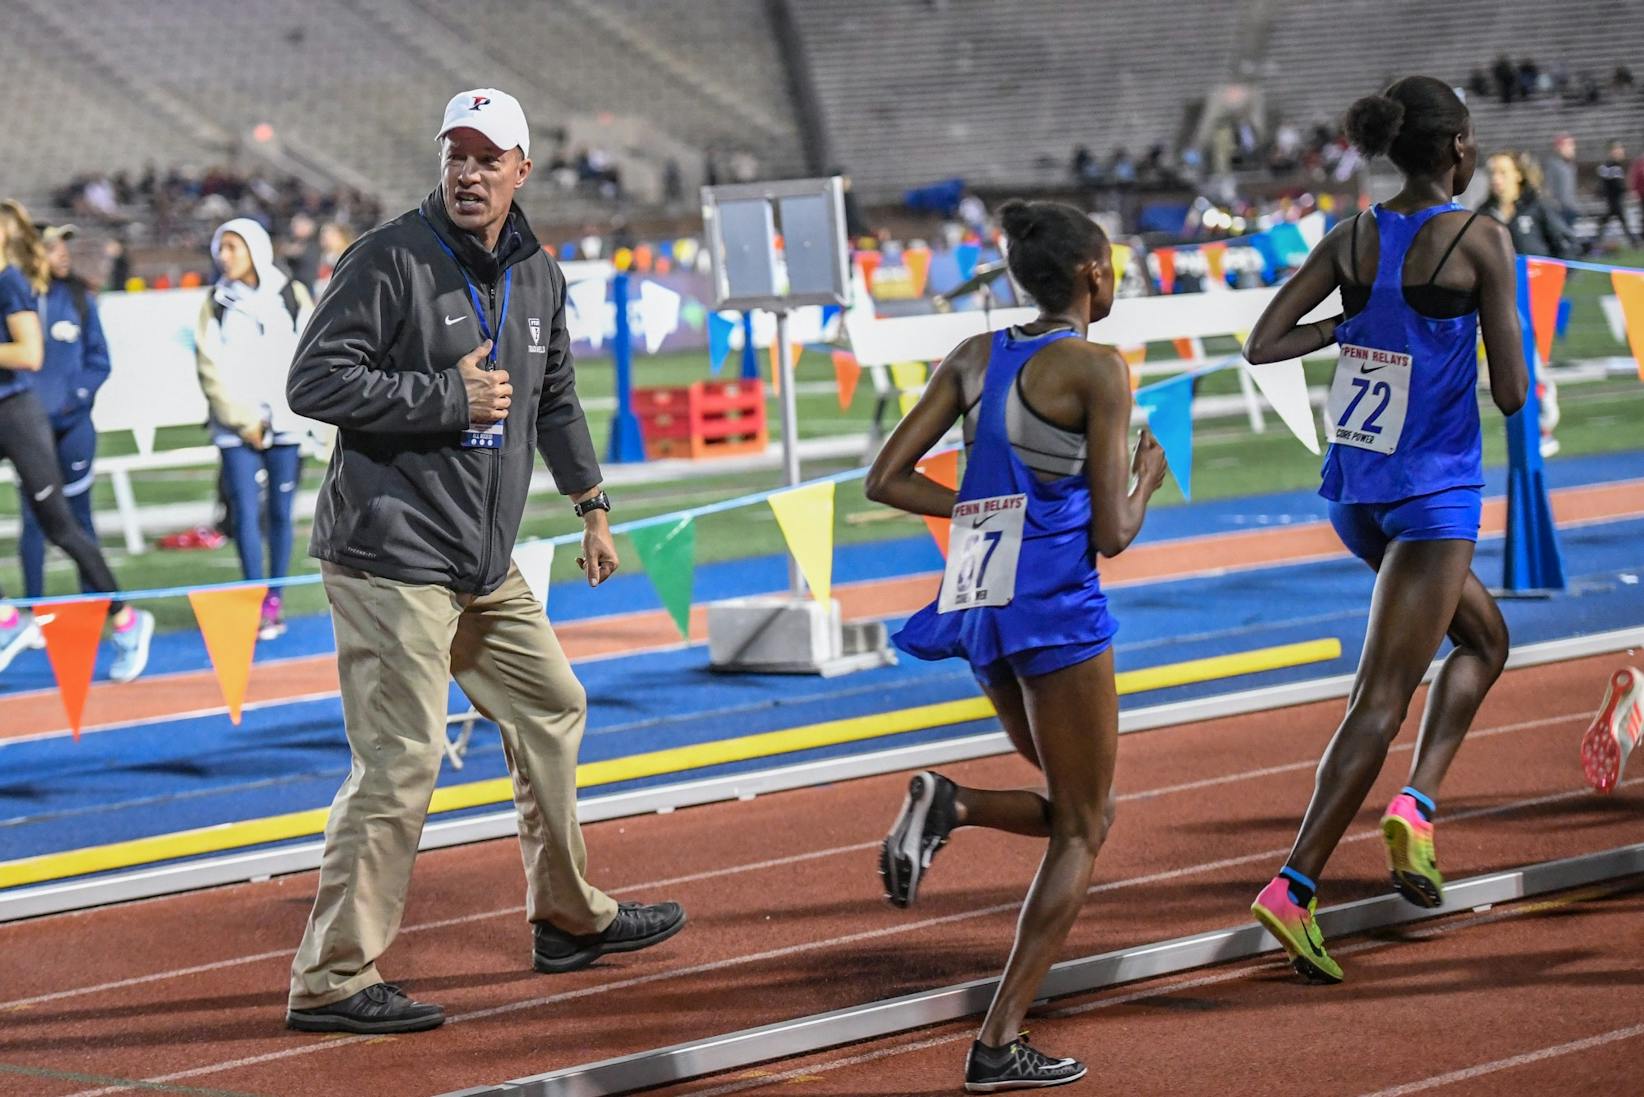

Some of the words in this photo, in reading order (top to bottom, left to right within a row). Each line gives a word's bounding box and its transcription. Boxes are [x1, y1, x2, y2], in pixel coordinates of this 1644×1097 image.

[469, 96, 491, 111] P
[1344, 346, 1369, 361] PENN
[1372, 351, 1409, 367] RELAYS
[1337, 377, 1391, 434] 72
[1351, 431, 1375, 444] POWER
[955, 502, 980, 517] PENN
[984, 497, 1025, 512] RELAYS
